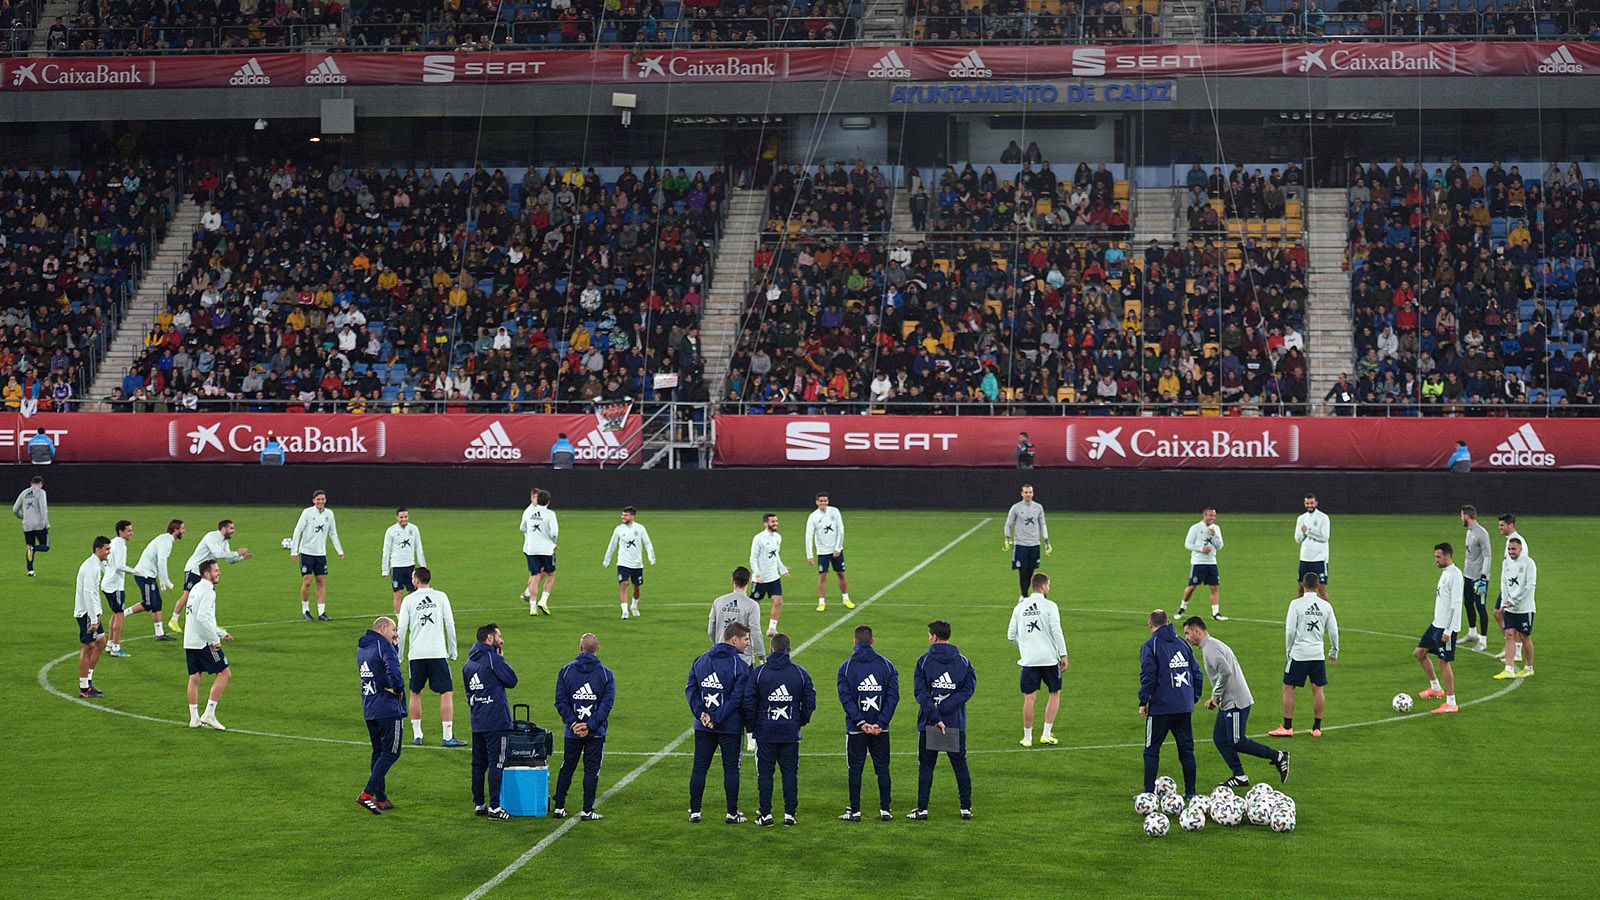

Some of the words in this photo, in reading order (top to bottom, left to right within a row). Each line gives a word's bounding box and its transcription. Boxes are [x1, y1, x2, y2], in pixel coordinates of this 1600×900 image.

[668, 56, 775, 77] CaixaBank
[1116, 55, 1201, 69] SEAT
[1330, 50, 1441, 71] CaixaBank
[465, 61, 546, 75] SEAT
[867, 67, 912, 78] adidas
[949, 67, 992, 78] adidas
[1538, 62, 1583, 73] adidas
[41, 64, 142, 84] CaixaBank
[305, 73, 347, 84] adidas
[229, 75, 270, 86] adidas
[891, 84, 1059, 104] AYUNTAMIENTO
[1067, 84, 1096, 103] DE
[844, 433, 958, 451] SEAT
[1130, 429, 1279, 458] CaixaBank
[464, 445, 521, 460] adidas
[1489, 450, 1556, 467] adidas
[701, 680, 724, 689] adidas
[857, 684, 882, 692] adidas
[931, 680, 956, 690] adidas
[572, 692, 597, 701] adidas
[767, 694, 793, 702] adidas
